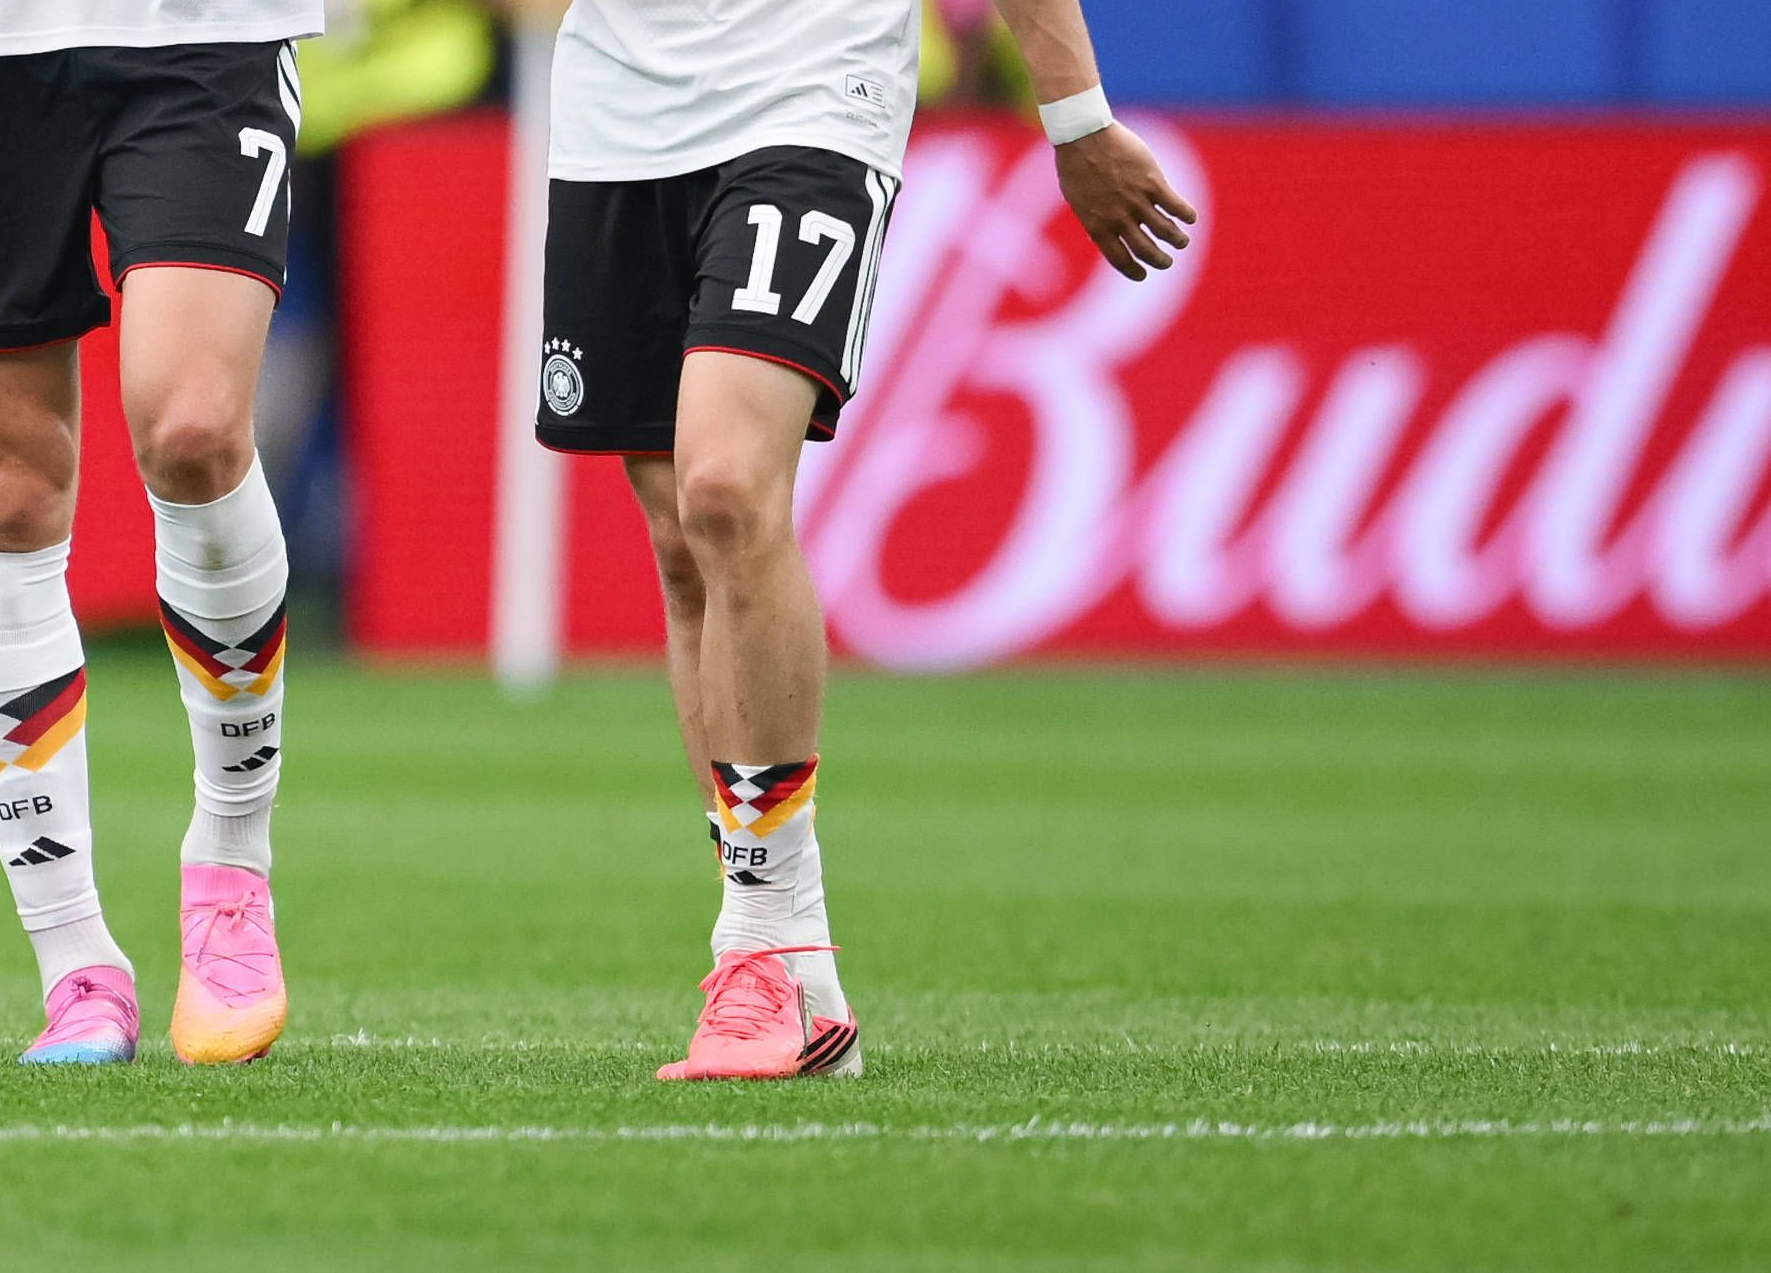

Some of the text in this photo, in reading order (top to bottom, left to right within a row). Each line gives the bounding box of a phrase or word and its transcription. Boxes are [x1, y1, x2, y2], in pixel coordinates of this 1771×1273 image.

[238, 127, 287, 237] 7
[731, 204, 856, 326] 17
[221, 712, 275, 738] DFB
[722, 840, 767, 866] DFB
